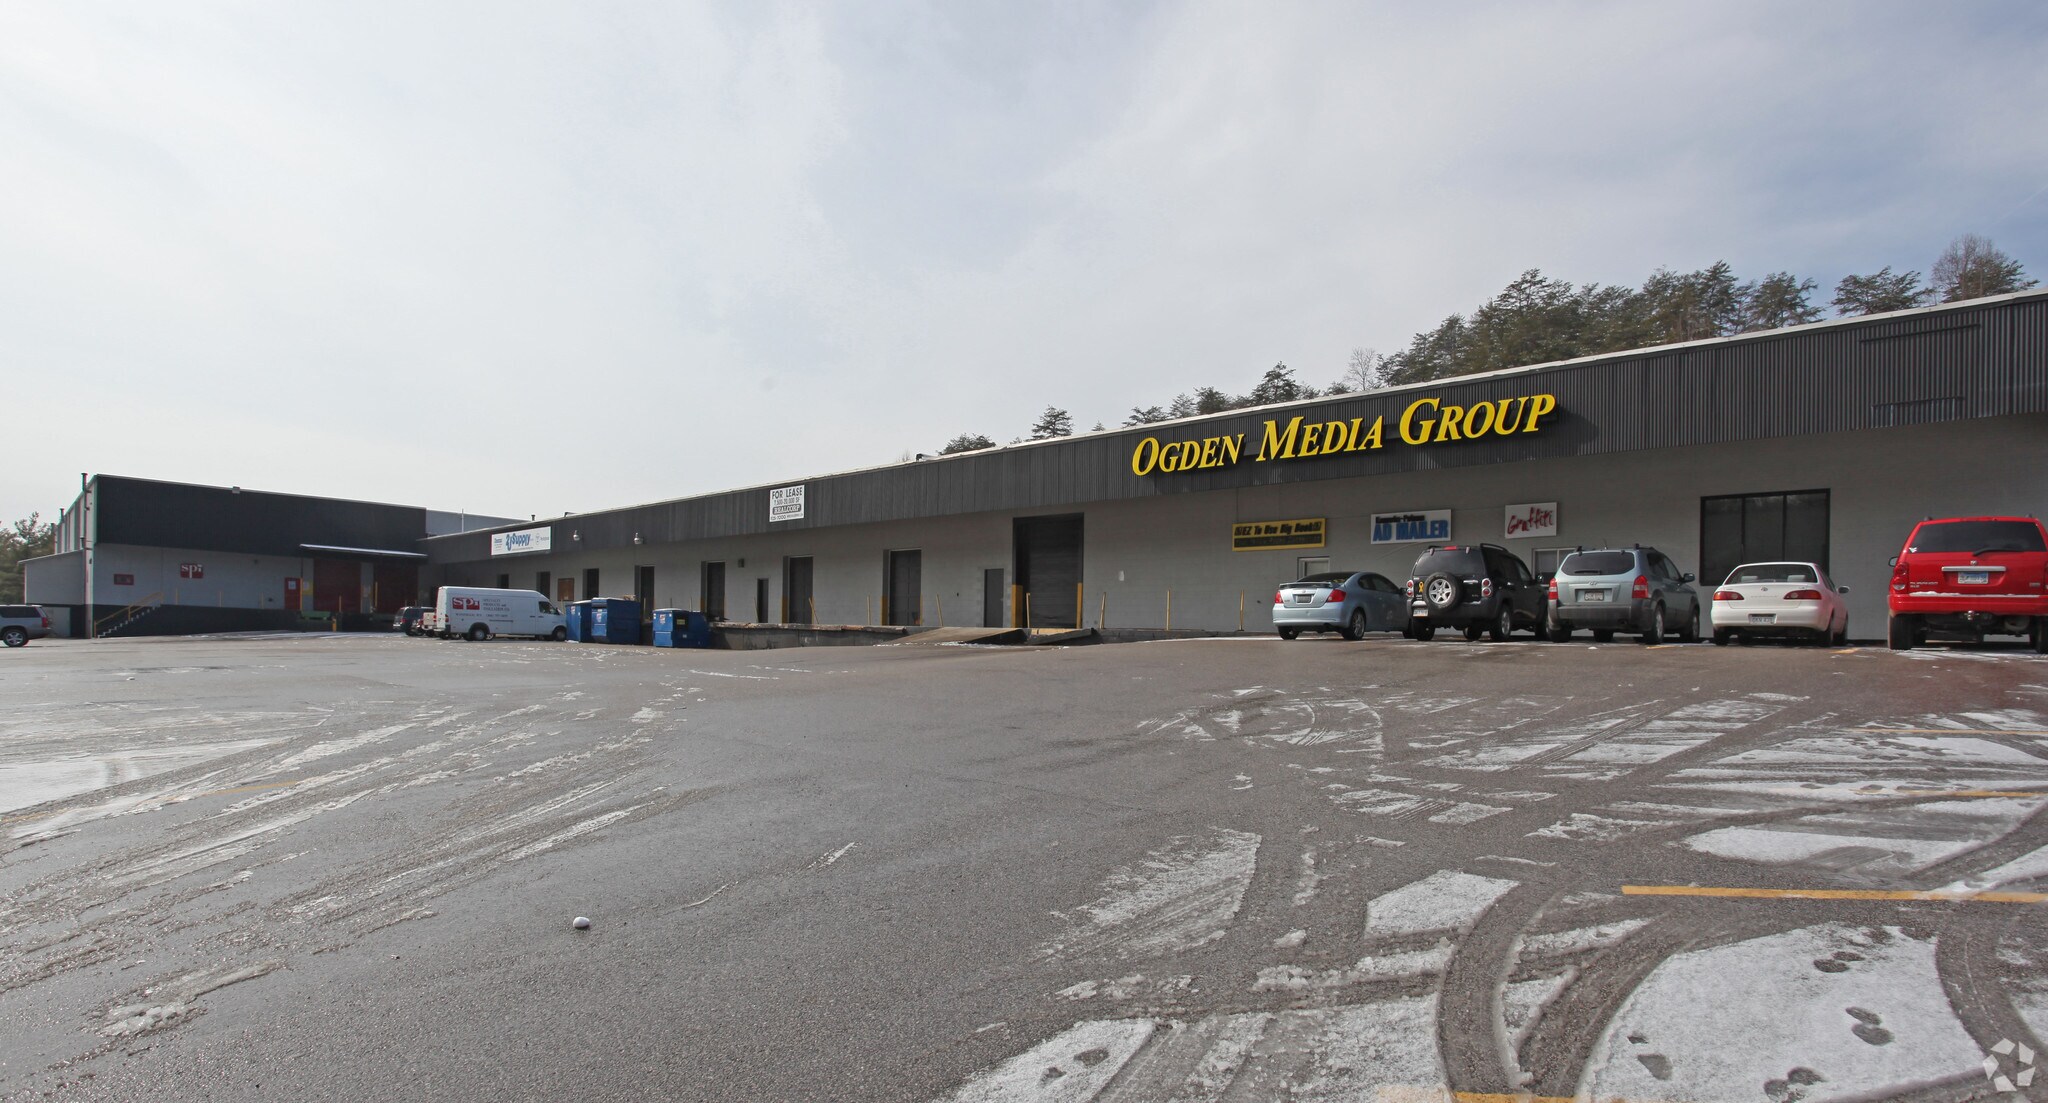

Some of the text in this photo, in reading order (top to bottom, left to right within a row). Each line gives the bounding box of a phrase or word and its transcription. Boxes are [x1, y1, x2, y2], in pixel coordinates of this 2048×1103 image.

[1132, 393, 1556, 476] OGDEN MEDIA GROUP
[772, 487, 802, 500] FOR LEASE
[1372, 520, 1449, 541] AD MAILER
[1507, 507, 1553, 535] Graffiti
